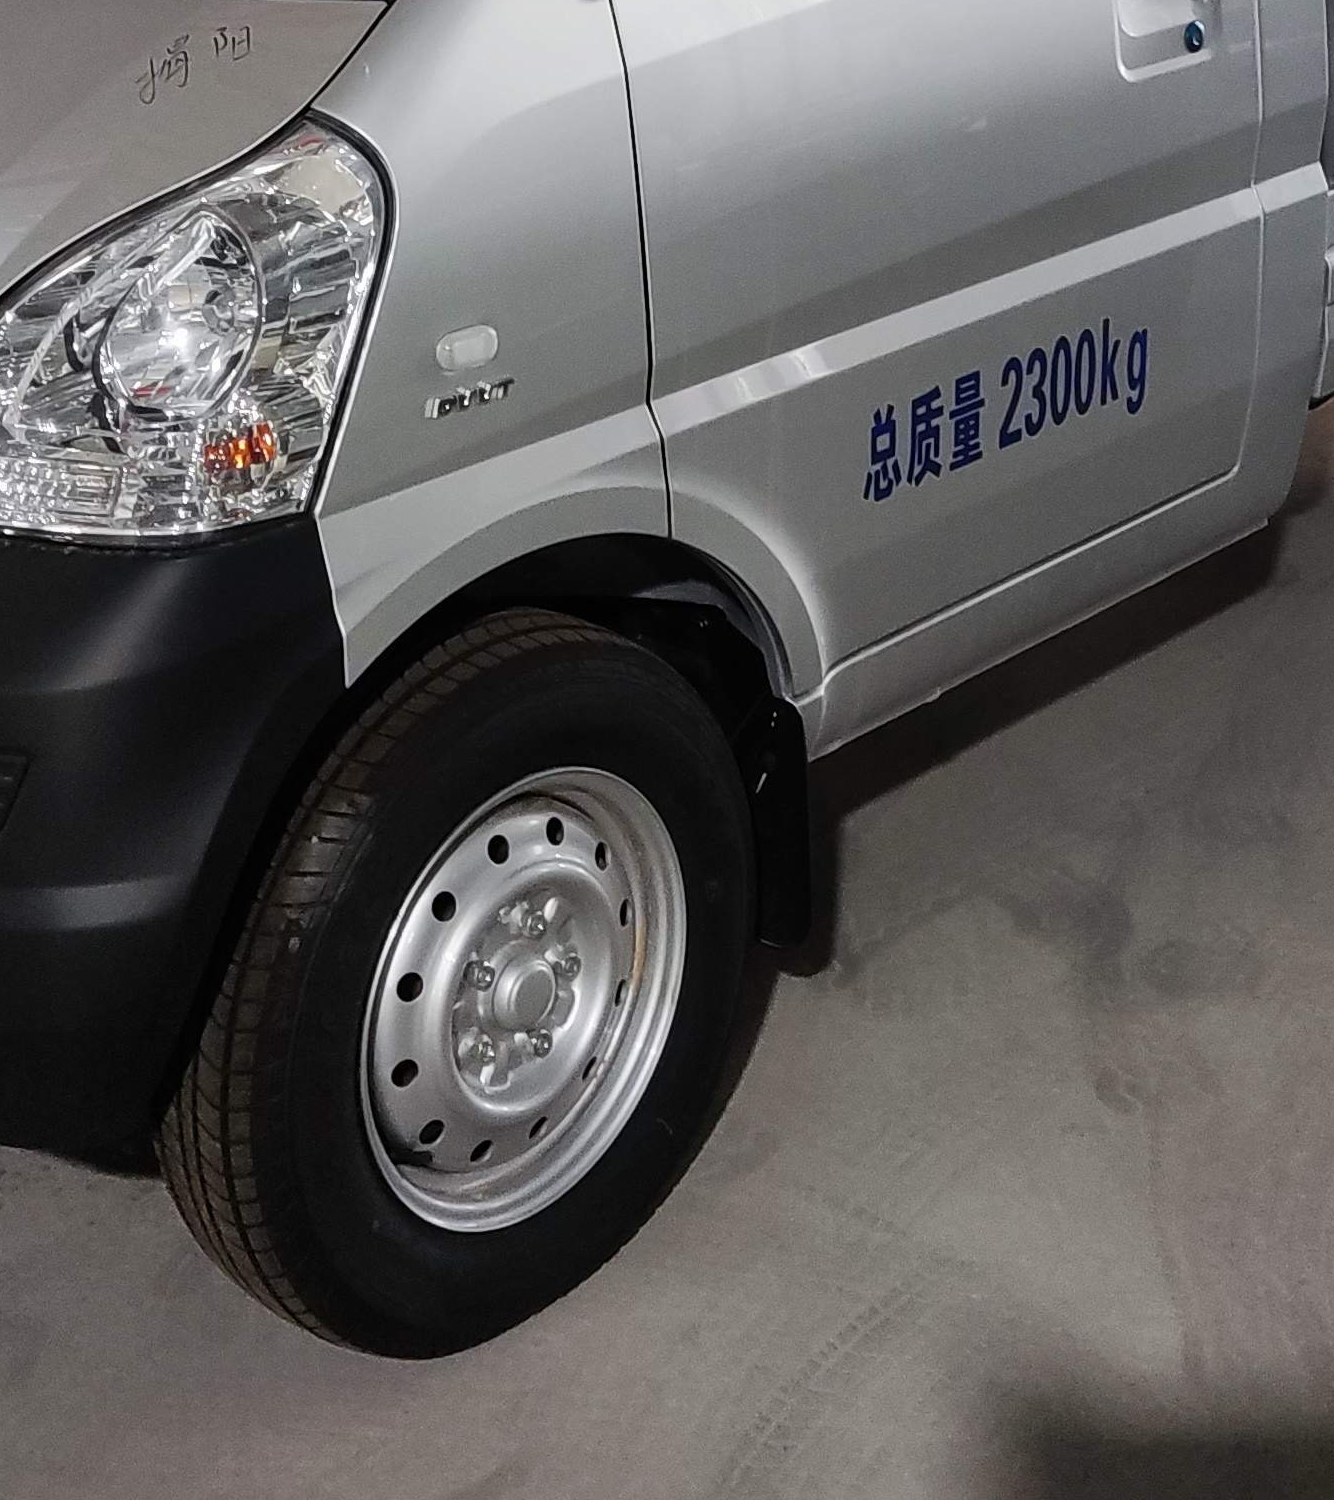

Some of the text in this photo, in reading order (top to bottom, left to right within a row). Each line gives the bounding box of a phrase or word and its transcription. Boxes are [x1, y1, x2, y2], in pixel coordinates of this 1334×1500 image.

[863, 317, 1148, 502] 总质量 2300kg
